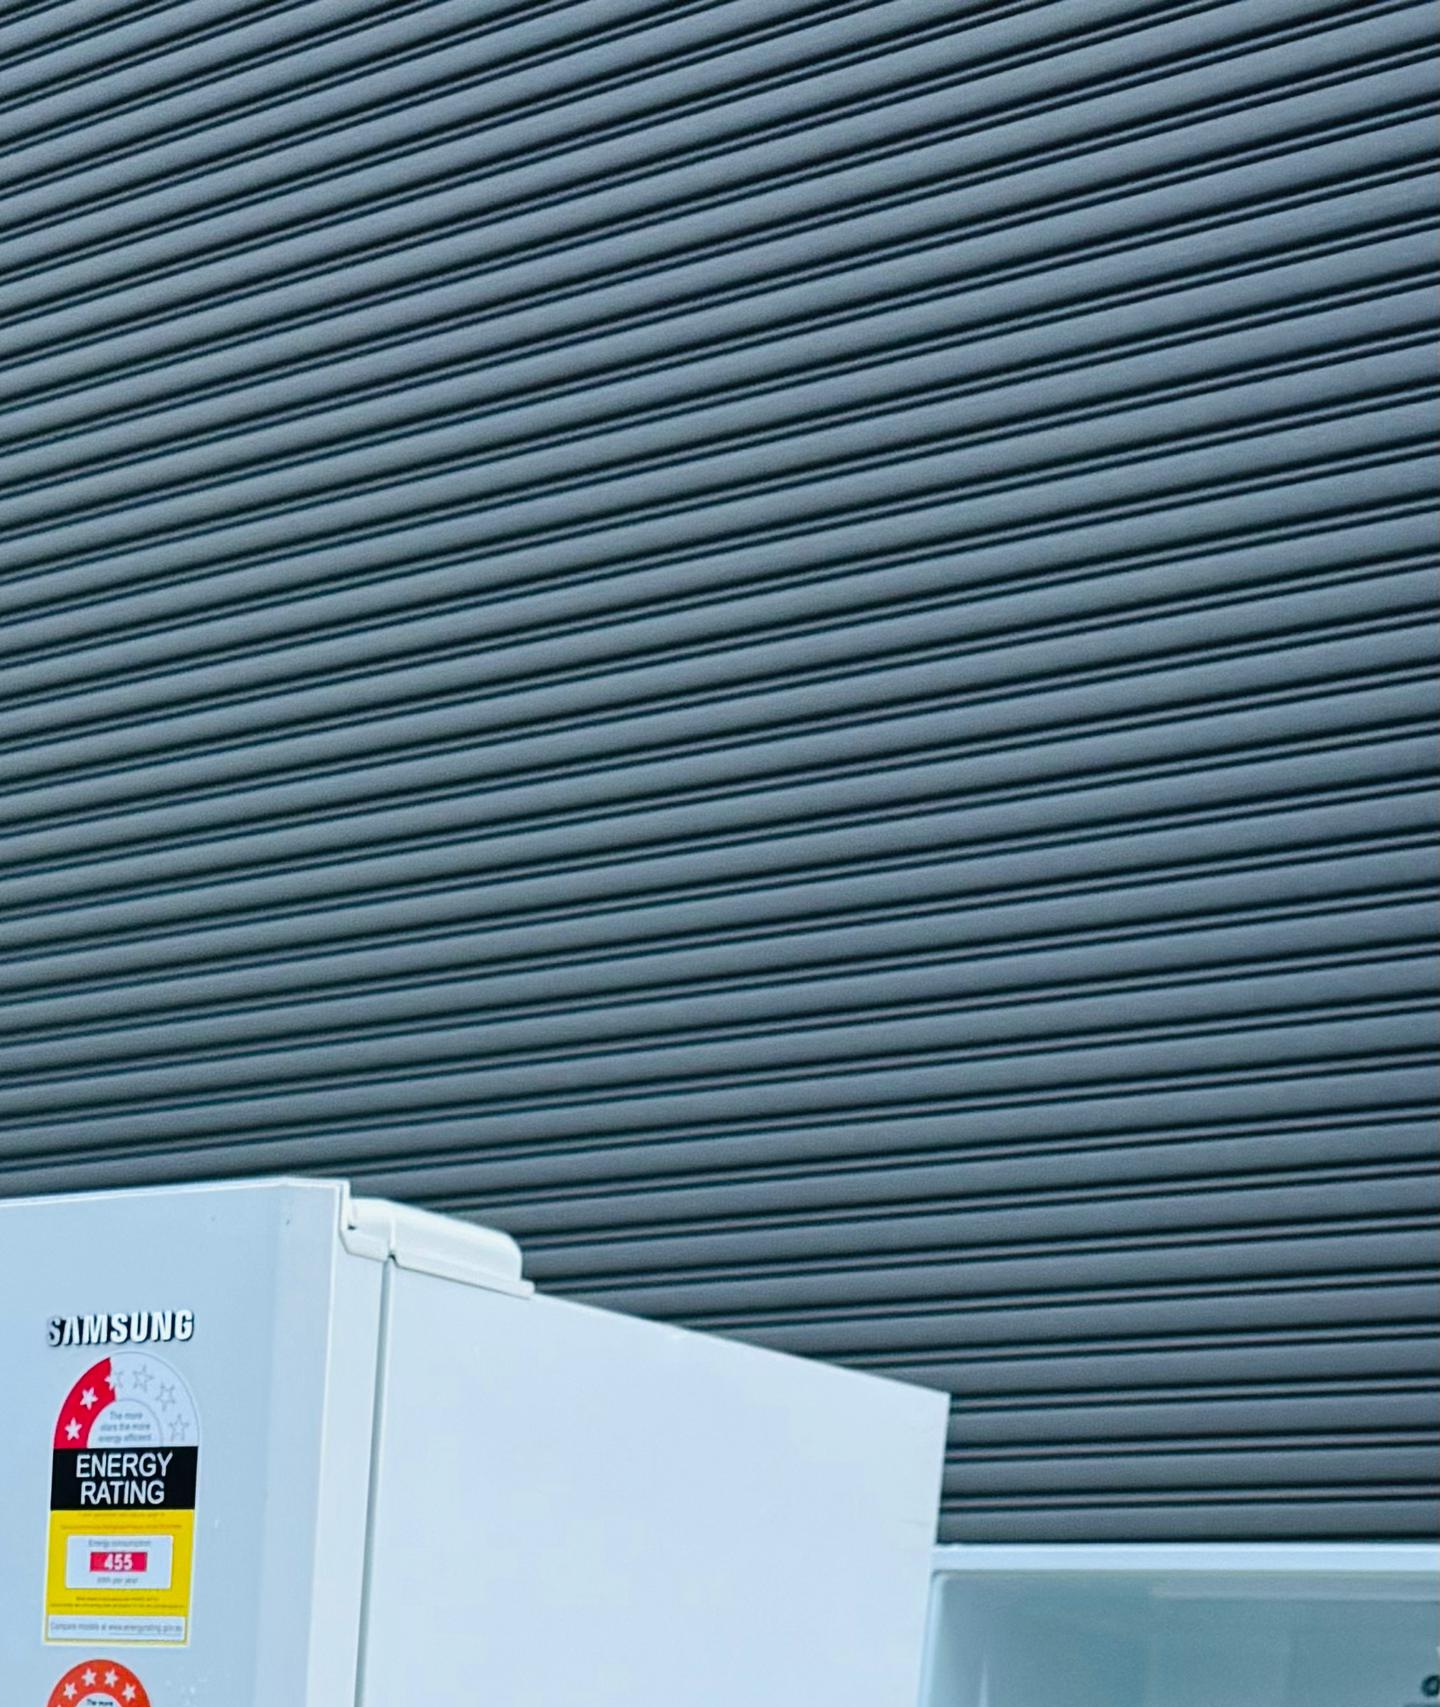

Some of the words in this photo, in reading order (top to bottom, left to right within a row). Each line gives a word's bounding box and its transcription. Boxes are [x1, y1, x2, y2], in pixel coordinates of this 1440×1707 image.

[47, 1309, 195, 1346] SAMSUNG
[75, 1452, 173, 1479] ENERGY
[80, 1479, 165, 1505] RATING
[104, 1553, 133, 1570] 455
